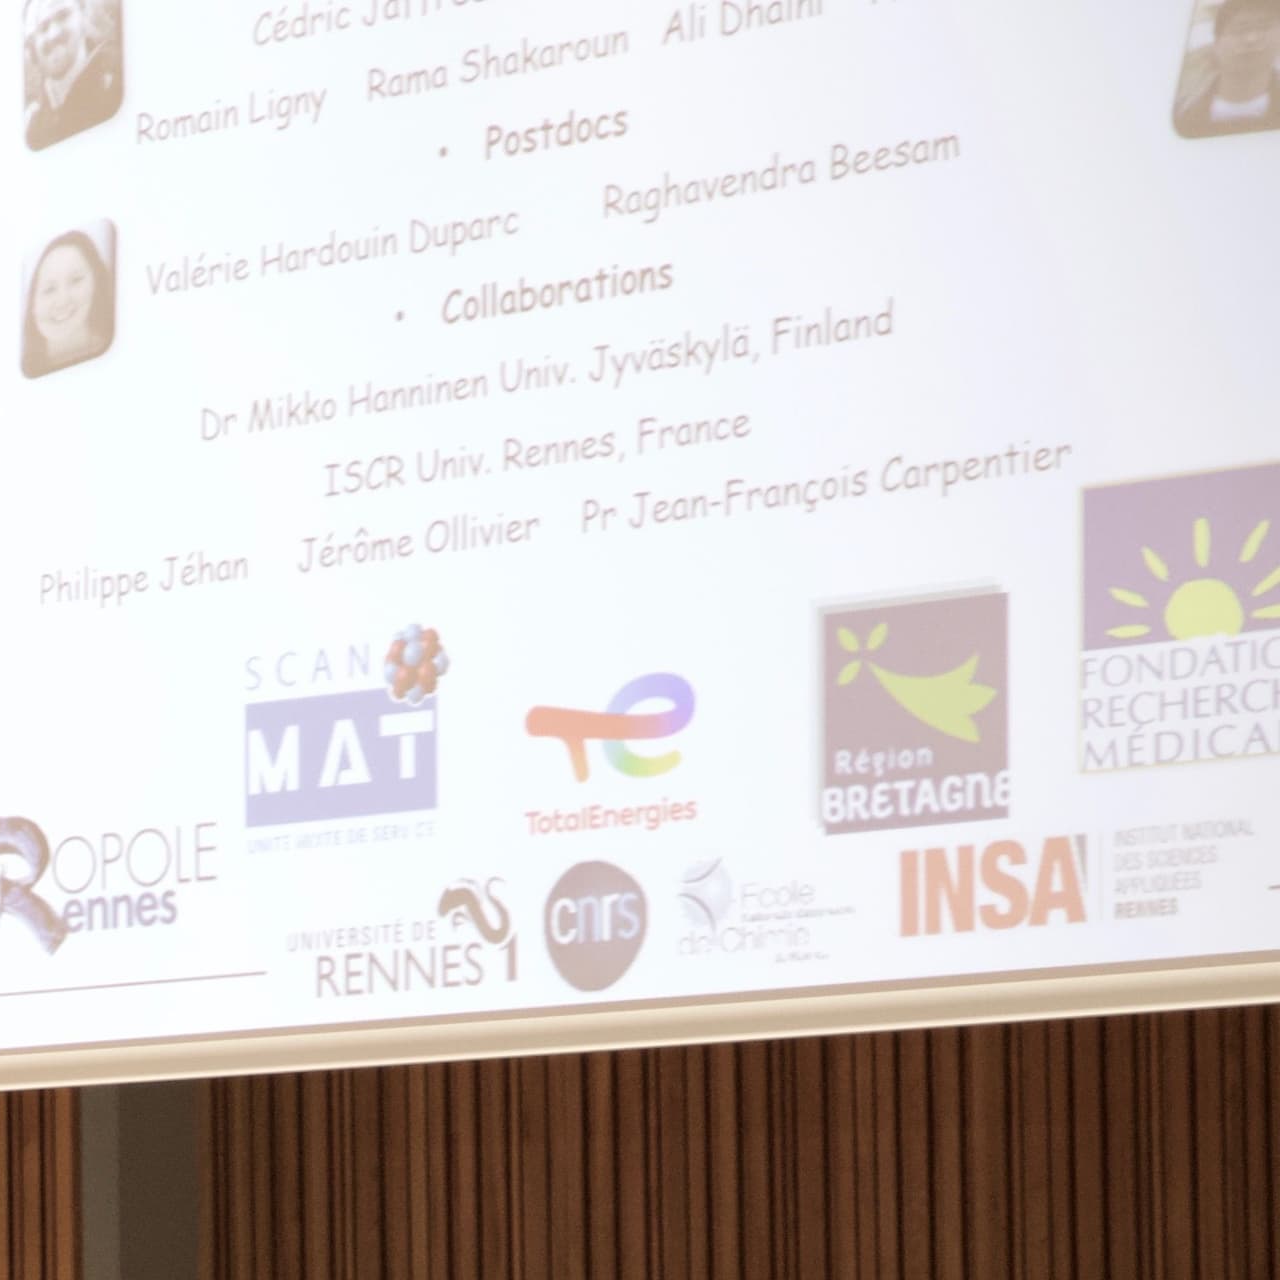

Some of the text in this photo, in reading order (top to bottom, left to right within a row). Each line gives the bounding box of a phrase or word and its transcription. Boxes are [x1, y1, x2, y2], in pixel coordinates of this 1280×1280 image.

[252, 1, 352, 46] Cédric
[661, 4, 706, 46] Ali
[366, 29, 629, 102] Rama Shakaroun
[135, 88, 327, 145] Romain Ligny
[484, 109, 629, 160] Postdocs
[602, 131, 961, 224] Raghavendra Beesam
[145, 210, 520, 296] Valérie Hardouin Duparc
[441, 262, 673, 324] Collaborations
[200, 295, 896, 442] Dr Mikko Hanninen Univ. Jyväskylä, Finland
[323, 412, 752, 498] ISCR Univ. Rennes, France
[581, 439, 1073, 533] Pr Jean-François Carpentier
[297, 512, 541, 574] Jérôme Ollivier
[40, 550, 249, 609] Philippe Jéhan
[245, 643, 370, 691] SCAN
[1080, 678, 1280, 730] RECHERC
[247, 709, 434, 795] MAT
[835, 747, 933, 776] Région
[1082, 721, 1280, 771] MÉDICA
[525, 797, 697, 835] TotalEnergies
[900, 833, 1087, 938] INSA
[288, 919, 436, 953] UNIVERSITÉ DE
[316, 943, 485, 998] RENNES
